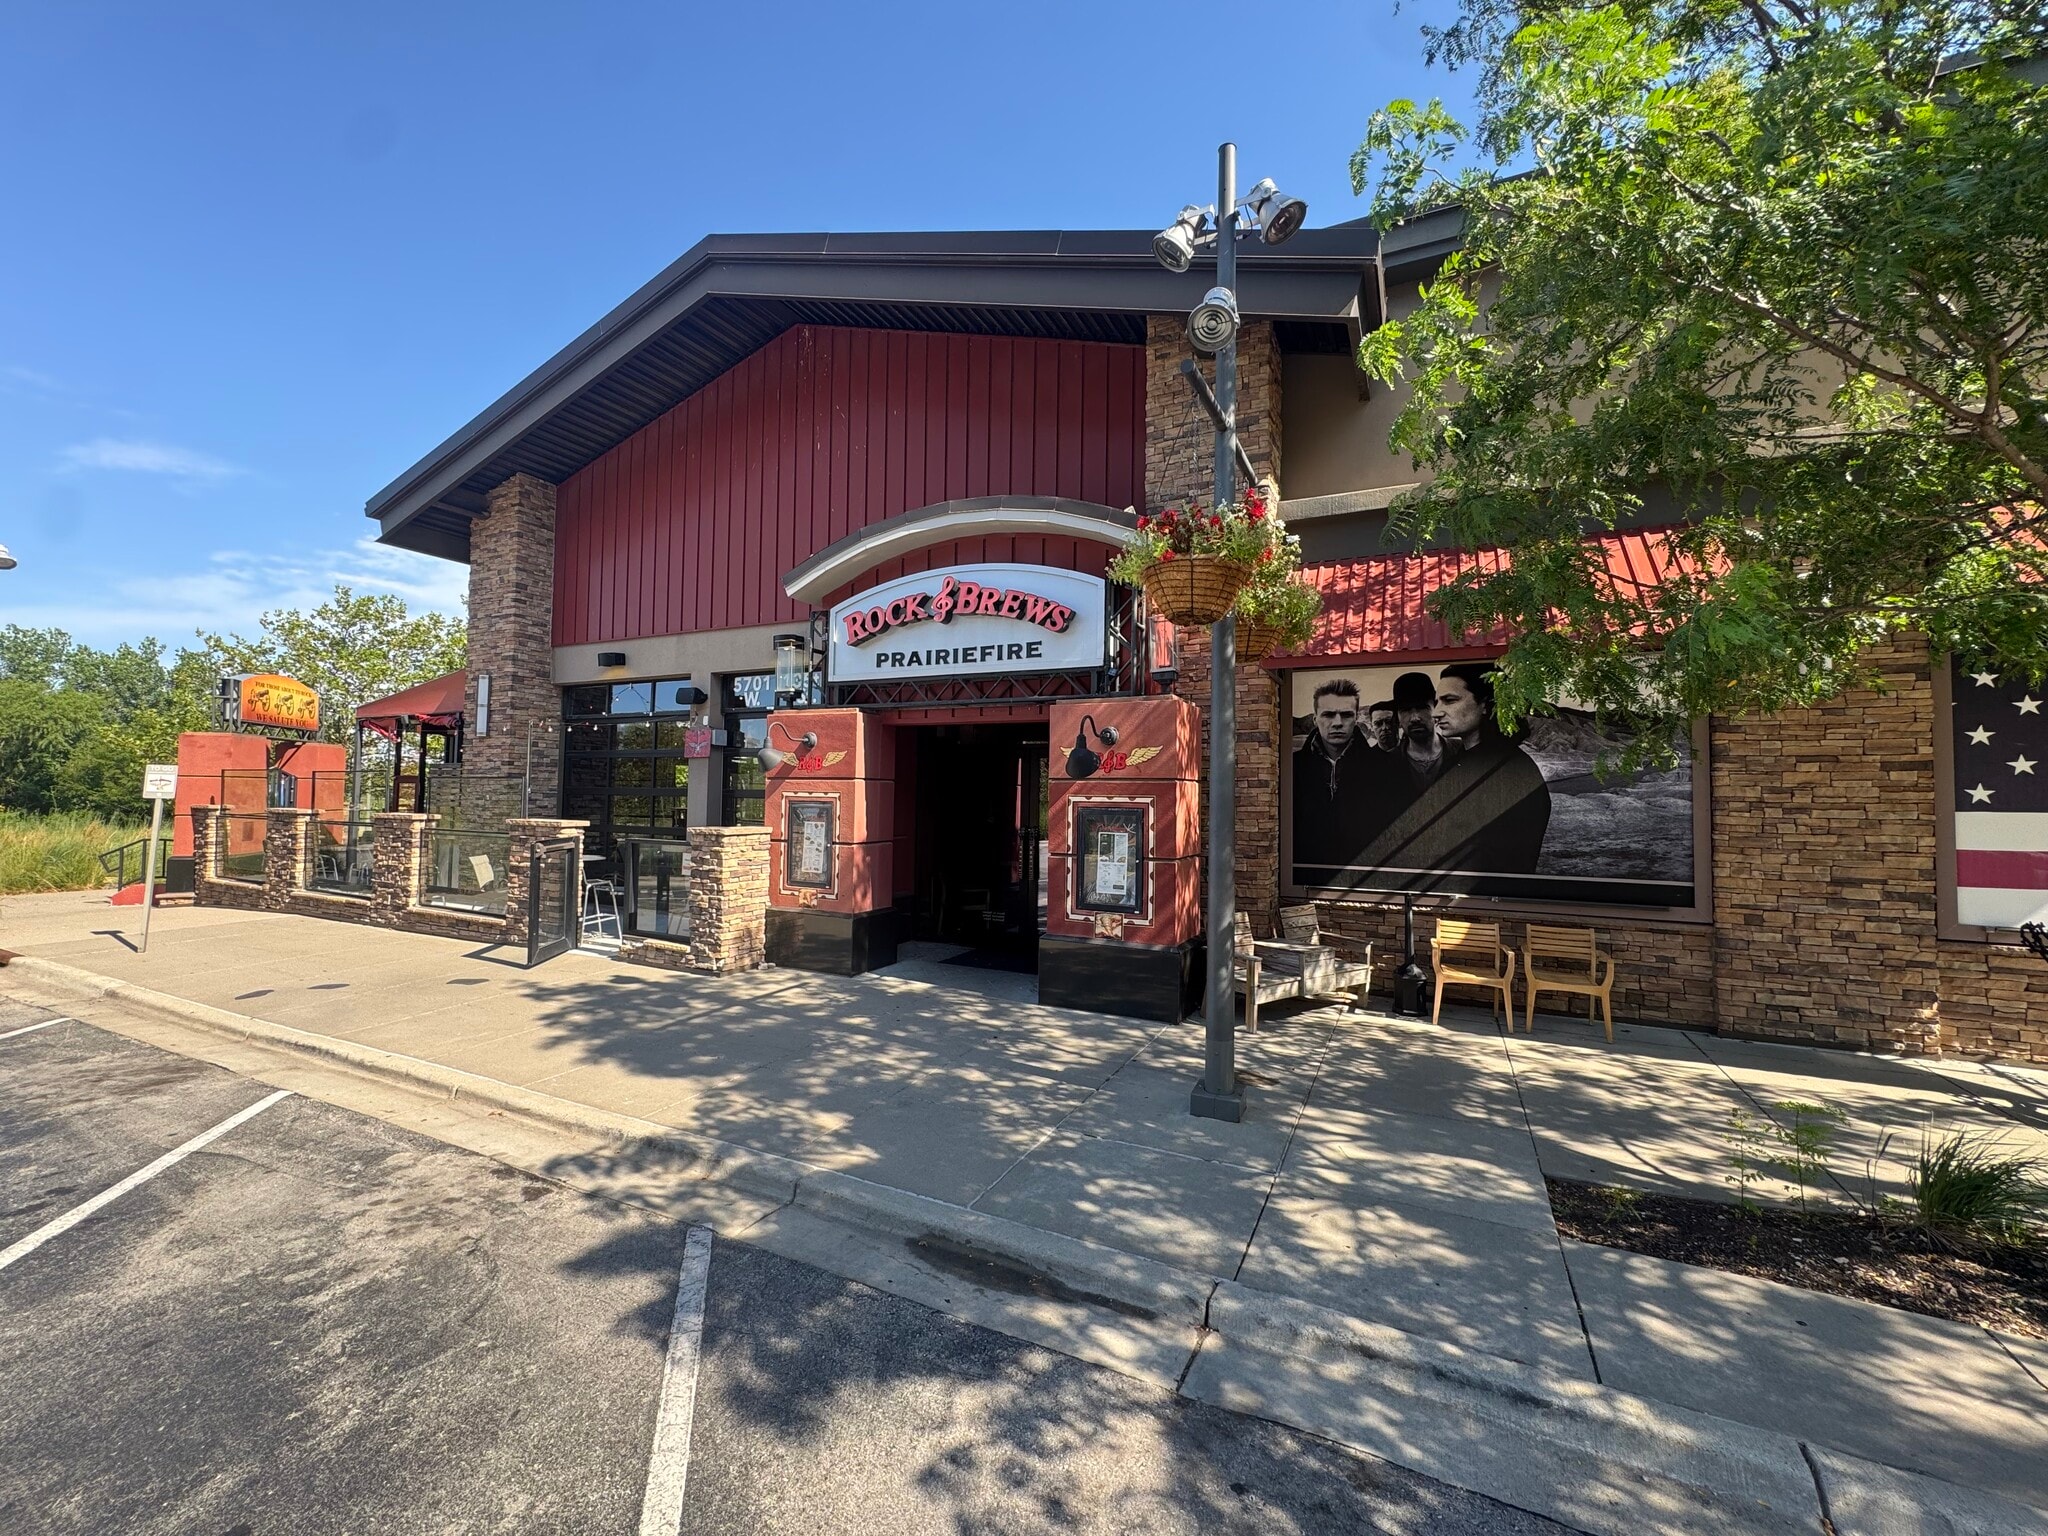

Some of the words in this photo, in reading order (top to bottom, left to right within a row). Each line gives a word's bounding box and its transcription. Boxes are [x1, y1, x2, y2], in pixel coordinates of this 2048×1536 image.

[843, 592, 929, 646] ROCK
[954, 581, 1075, 633] BREWS
[876, 641, 1042, 668] PRAIRIEFIRE
[733, 675, 770, 692] 5701
[743, 691, 760, 708] W.
[256, 713, 267, 722] WE
[269, 715, 294, 726] SALUTE
